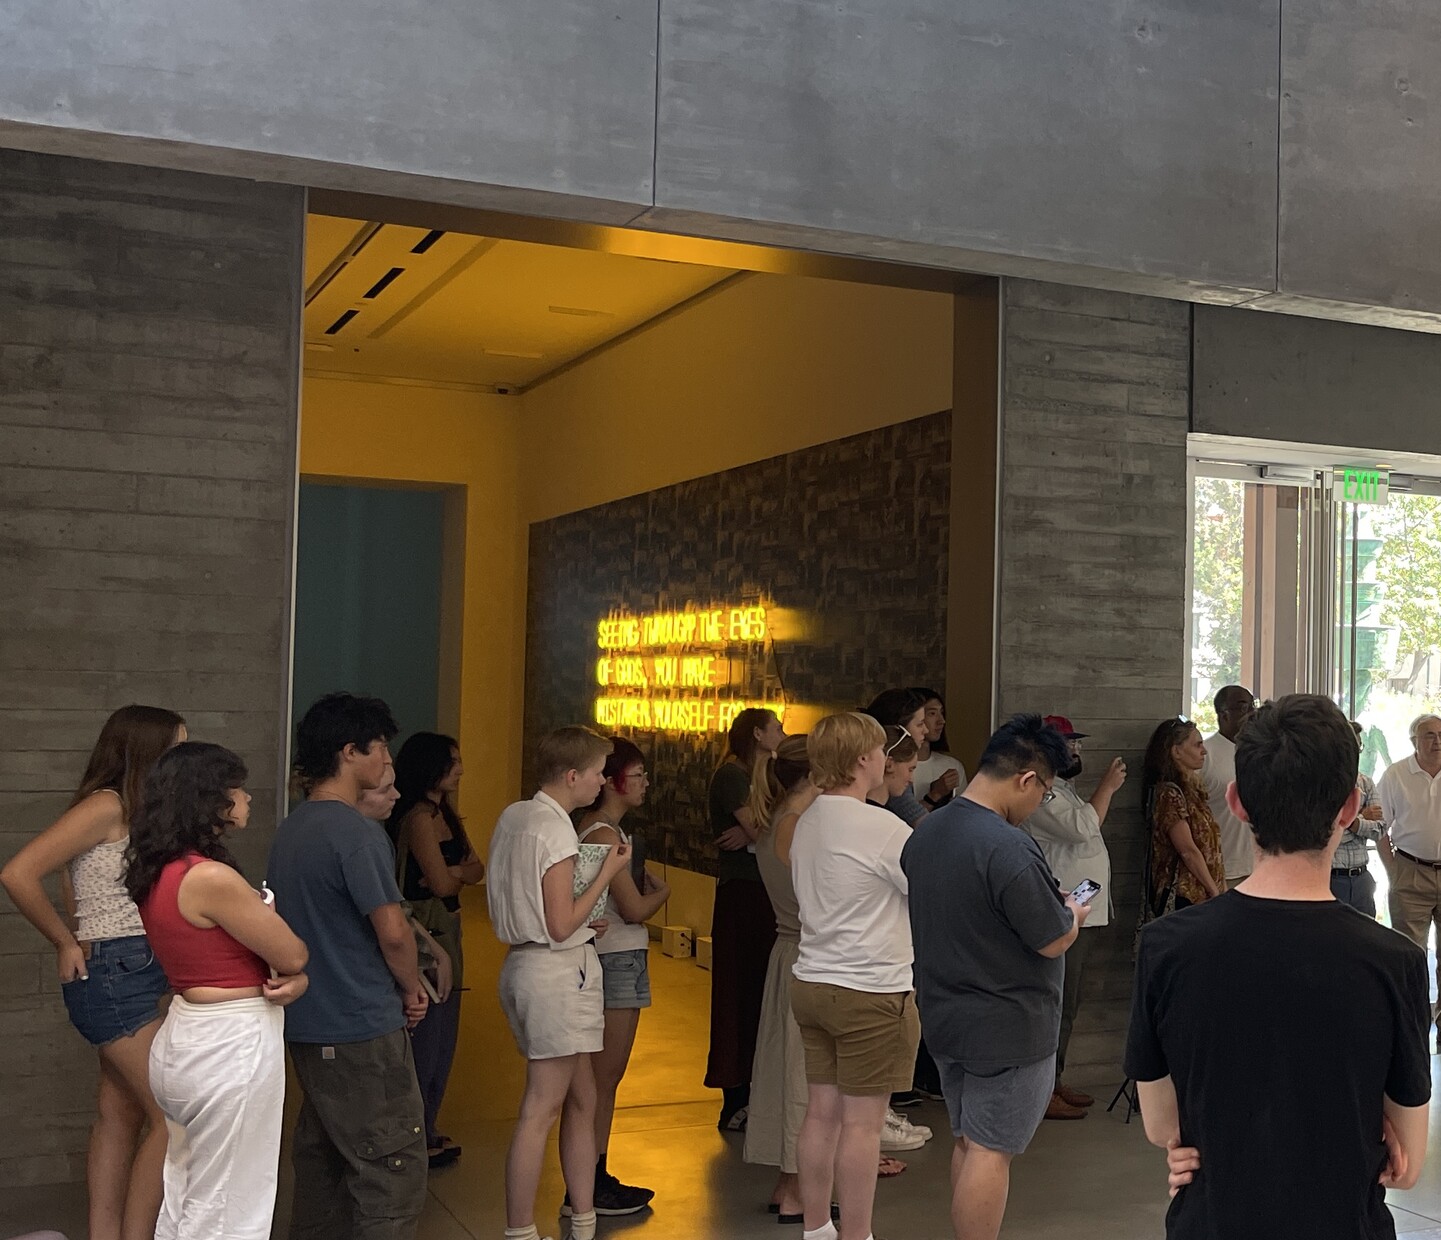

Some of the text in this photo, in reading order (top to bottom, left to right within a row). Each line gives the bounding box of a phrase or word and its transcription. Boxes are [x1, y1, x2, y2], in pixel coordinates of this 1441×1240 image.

[1344, 469, 1379, 501] EXIT
[598, 608, 766, 649] SEEING THROUGH THE EYES
[597, 656, 716, 689] OF GODS, YOU HAVE
[596, 697, 651, 727] MISTAKEN
[654, 699, 715, 731] YOURSELF
